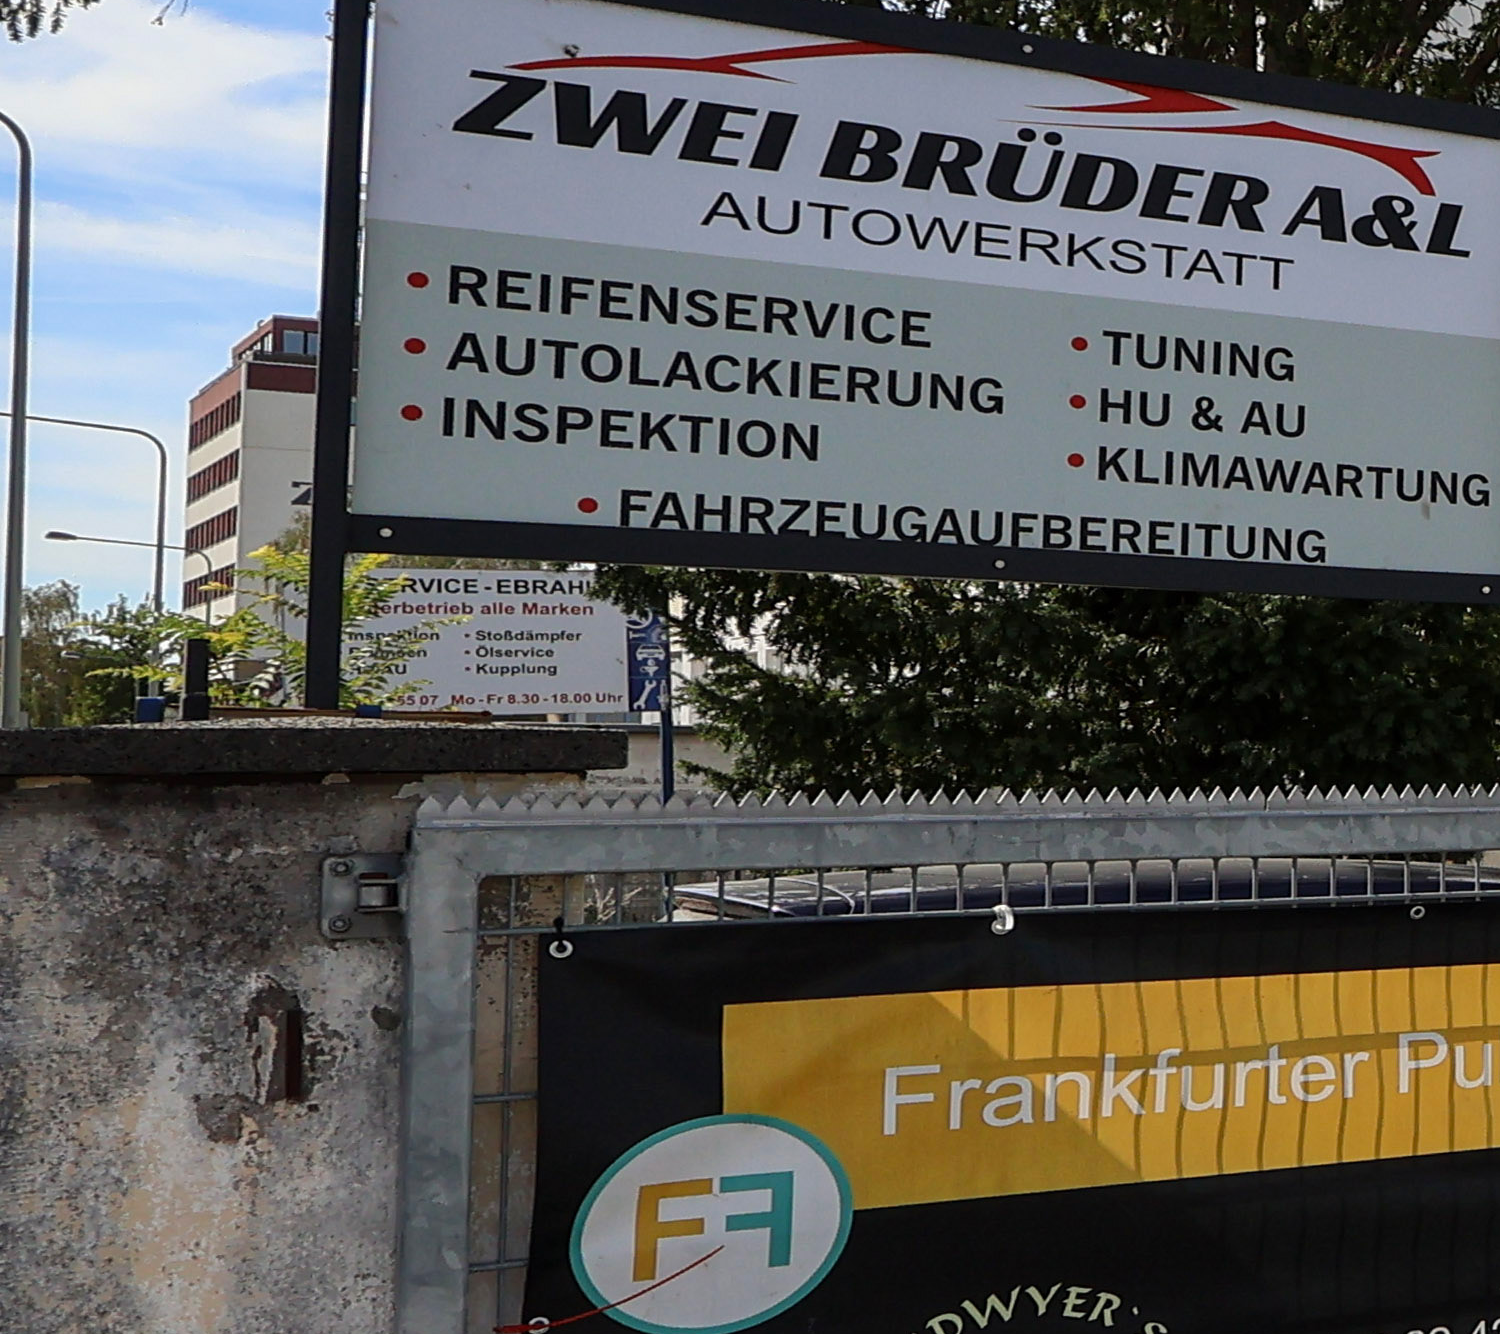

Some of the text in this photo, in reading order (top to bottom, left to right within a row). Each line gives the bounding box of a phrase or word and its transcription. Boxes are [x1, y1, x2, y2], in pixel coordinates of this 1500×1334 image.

[452, 69, 1471, 259] ZWEI BRÜDER A&L
[701, 191, 1295, 291] AUTOWERKSTATT
[448, 264, 932, 348] REIFENSERVICE
[446, 331, 1004, 415] AUTOLACKIERUNG
[1102, 330, 1295, 382] TUNING
[441, 396, 819, 462] INSPEKTION
[1098, 387, 1306, 439] HU & AU
[1096, 445, 1491, 508] KLIMAWARTUNG
[619, 488, 1327, 564] FAHRZEUGAUFBEREITUNG
[366, 578, 479, 594] RVICE
[382, 601, 594, 616] erbetrieb alle Marken
[475, 630, 582, 644] Stoßdämpfer
[475, 644, 554, 658] Ölservice
[451, 694, 475, 705] Mo
[507, 693, 540, 704] 8.30
[551, 693, 592, 704] 18.00
[596, 692, 623, 704] Uhr
[475, 663, 557, 677] Kupplung
[881, 1044, 1370, 1136] Frankfurter
